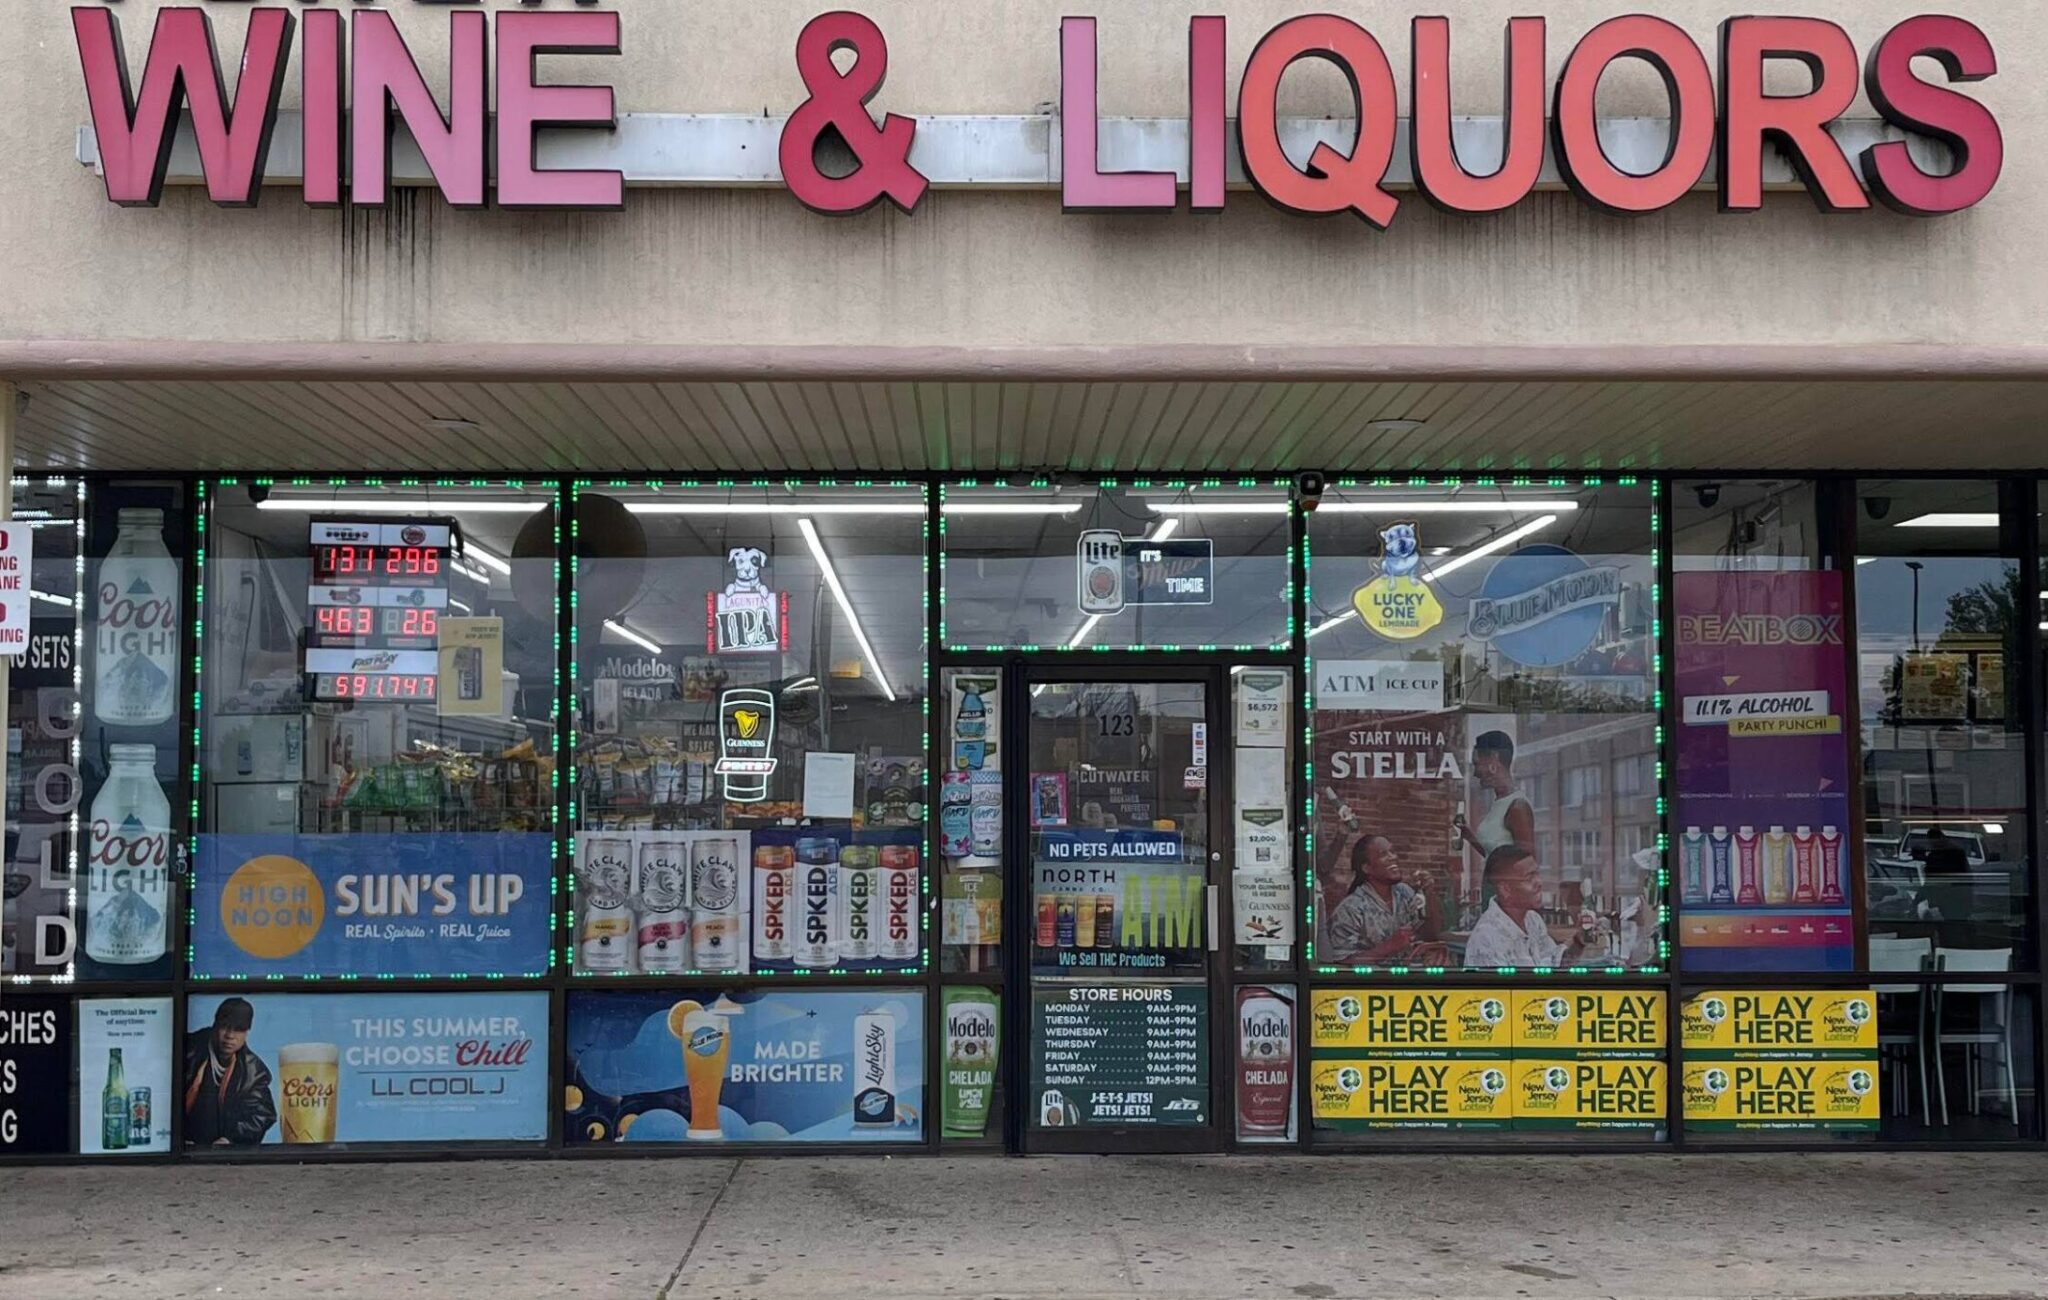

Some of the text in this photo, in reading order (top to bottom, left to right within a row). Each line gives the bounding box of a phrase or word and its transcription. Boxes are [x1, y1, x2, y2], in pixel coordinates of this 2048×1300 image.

[72, 6, 2002, 231] WINE & LIQUORS
[328, 547, 439, 574] 131 296
[1140, 550, 1161, 562] IT'S
[1166, 577, 1204, 593] TIME
[1545, 571, 1617, 611] MOON
[1374, 593, 1425, 606] LUCKY
[318, 608, 372, 634] 463
[1382, 607, 1415, 619] ONE
[716, 607, 778, 650] IPA
[1379, 620, 1419, 628] LEMONADE
[1679, 612, 1843, 645] BEATBOX
[31, 635, 70, 669] SETS
[606, 657, 666, 678] Modelo
[1322, 675, 1439, 692] ATM ICE CUP
[1696, 697, 1813, 716] 11.1% ALCOHOL
[1100, 714, 1134, 736] 123
[1737, 719, 1827, 731] PARTY PUNCH!
[726, 738, 766, 748] GUINNESS
[1350, 731, 1445, 745] START WITH A
[1331, 751, 1463, 779] STELLA
[1080, 770, 1150, 783] CUTWATER
[1050, 842, 1175, 857] NO PETS ALLOWED
[602, 855, 628, 874] CLAW
[656, 858, 683, 876] CLAW
[708, 856, 736, 874] CLAW
[238, 886, 309, 904] HIGH
[335, 873, 524, 917] SUN'S UP
[765, 872, 784, 940] SPKED
[807, 867, 837, 944] SPKED ADE
[850, 872, 878, 940] SPKED ADE
[890, 872, 917, 940] SPKED ADE
[1121, 876, 1201, 948] ATM
[1249, 901, 1290, 911] GUINNESS
[231, 908, 313, 927] NOON
[345, 924, 511, 942] REAL Spirits REAL Juice
[1059, 952, 1166, 967] We Sell THC Products
[1069, 988, 1173, 1001] STORE HOURS
[1045, 1004, 1196, 1013] MONDAY 9AM-9PM
[1368, 995, 1448, 1018] PLAY
[1576, 996, 1657, 1018] PLAY
[1733, 996, 1813, 1019] PLAY
[1045, 1016, 1196, 1025] TUESDAY 9AM-9PM
[1315, 1013, 1336, 1022] New
[1523, 1013, 1545, 1022] New
[1824, 1015, 1845, 1024] New
[352, 1017, 525, 1040] THIS SUMMER,
[948, 1017, 995, 1038] Modelo
[1045, 1028, 1196, 1037] WEDNESDAY 9AM-9PM
[1242, 1017, 1289, 1038] Modelo
[1369, 1019, 1448, 1042] HERE
[1577, 1020, 1656, 1043] HERE
[1734, 1021, 1814, 1043] HERE
[346, 1039, 532, 1067] CHOOSE Chill
[754, 1041, 821, 1059] MADE
[1045, 1040, 1196, 1049] THURSDAY 9AM-9PM
[1045, 1052, 1196, 1061] FRIDAY 9AM-9PM
[731, 1064, 843, 1083] BRIGHTER
[949, 1071, 993, 1085] CHELADA
[1045, 1064, 1196, 1073] SATURDAY 9AM-9PM
[1245, 1070, 1288, 1085] CHELADA
[1369, 1066, 1449, 1088] PLAY
[1576, 1066, 1657, 1088] PLAY
[1735, 1067, 1816, 1089] PLAY
[283, 1078, 335, 1098] Coors
[372, 1077, 504, 1096] LL COOL J
[1045, 1076, 1085, 1084] SUNDAY
[288, 1097, 329, 1108] LIGHT
[1125, 1092, 1153, 1103] JETS!
[1162, 1098, 1200, 1110] JETS
[1369, 1090, 1448, 1113] HERE
[1577, 1090, 1656, 1113] HERE
[1736, 1091, 1816, 1114] HERE
[1093, 1104, 1150, 1116] JETS! JETS!
